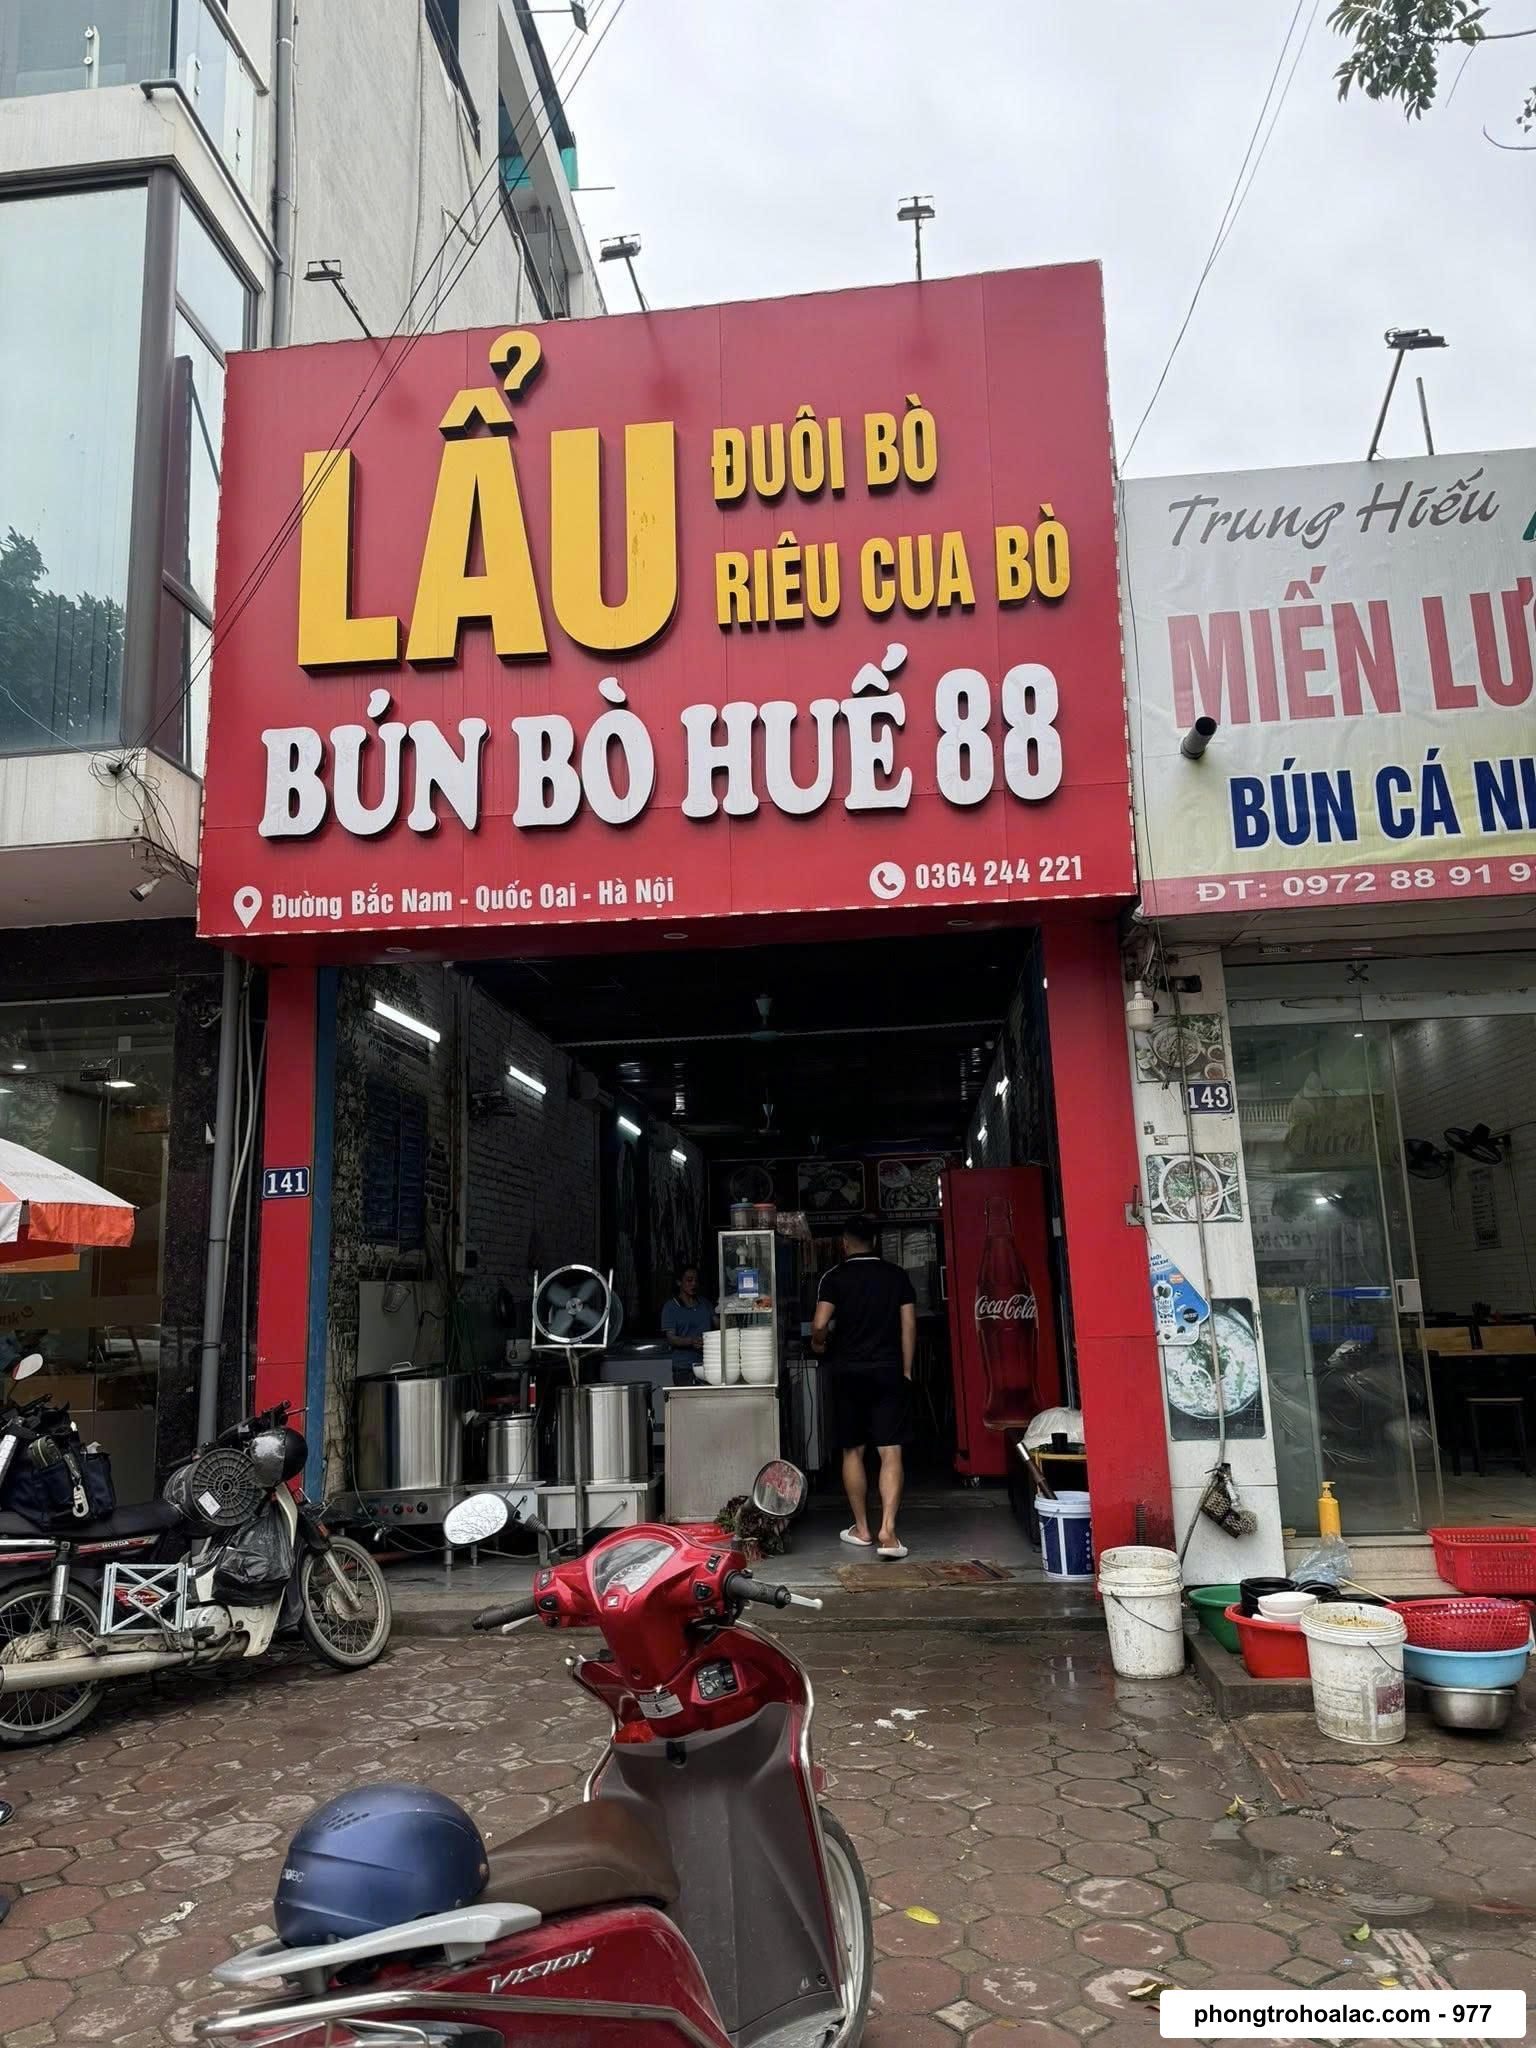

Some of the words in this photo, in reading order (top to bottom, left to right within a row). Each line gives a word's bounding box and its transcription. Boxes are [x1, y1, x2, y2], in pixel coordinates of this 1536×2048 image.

[711, 405, 846, 502] ĐUÔI
[864, 393, 938, 490] BÒ
[297, 330, 678, 668] LẨU
[1168, 494, 1345, 550] Trung
[1356, 467, 1500, 534] Hiếu
[715, 530, 841, 628] RIÊU
[860, 531, 976, 614] CUA
[995, 503, 1071, 603] BÒ
[1167, 565, 1402, 728] MIẾN
[1422, 576, 1536, 711] LƯ
[258, 688, 490, 840] BÚN
[511, 677, 656, 828] BÒ
[680, 643, 913, 819] HUẾ
[935, 663, 1063, 806] 88
[1229, 757, 1358, 849] BÚN
[1375, 747, 1461, 839] CÁ
[272, 889, 342, 920] Đường
[351, 882, 394, 915] Bắc
[402, 888, 453, 913] Nam
[476, 880, 533, 912] Quốc
[540, 882, 576, 909] Oai
[599, 879, 628, 906] Hà
[636, 877, 674, 908] Nội
[915, 862, 977, 889] 0364
[984, 858, 1031, 886] 244
[1039, 855, 1082, 882] 221
[1196, 881, 1267, 902] ĐT:
[1282, 871, 1376, 897] 0972
[1390, 868, 1435, 890] 88
[1449, 864, 1491, 886] 91
[1509, 862, 1536, 882] 9
[1188, 1086, 1230, 1109] 143
[267, 1171, 305, 1194] 141
[975, 1294, 1038, 1320] Coca-Cola
[487, 1947, 595, 1994] VISION
